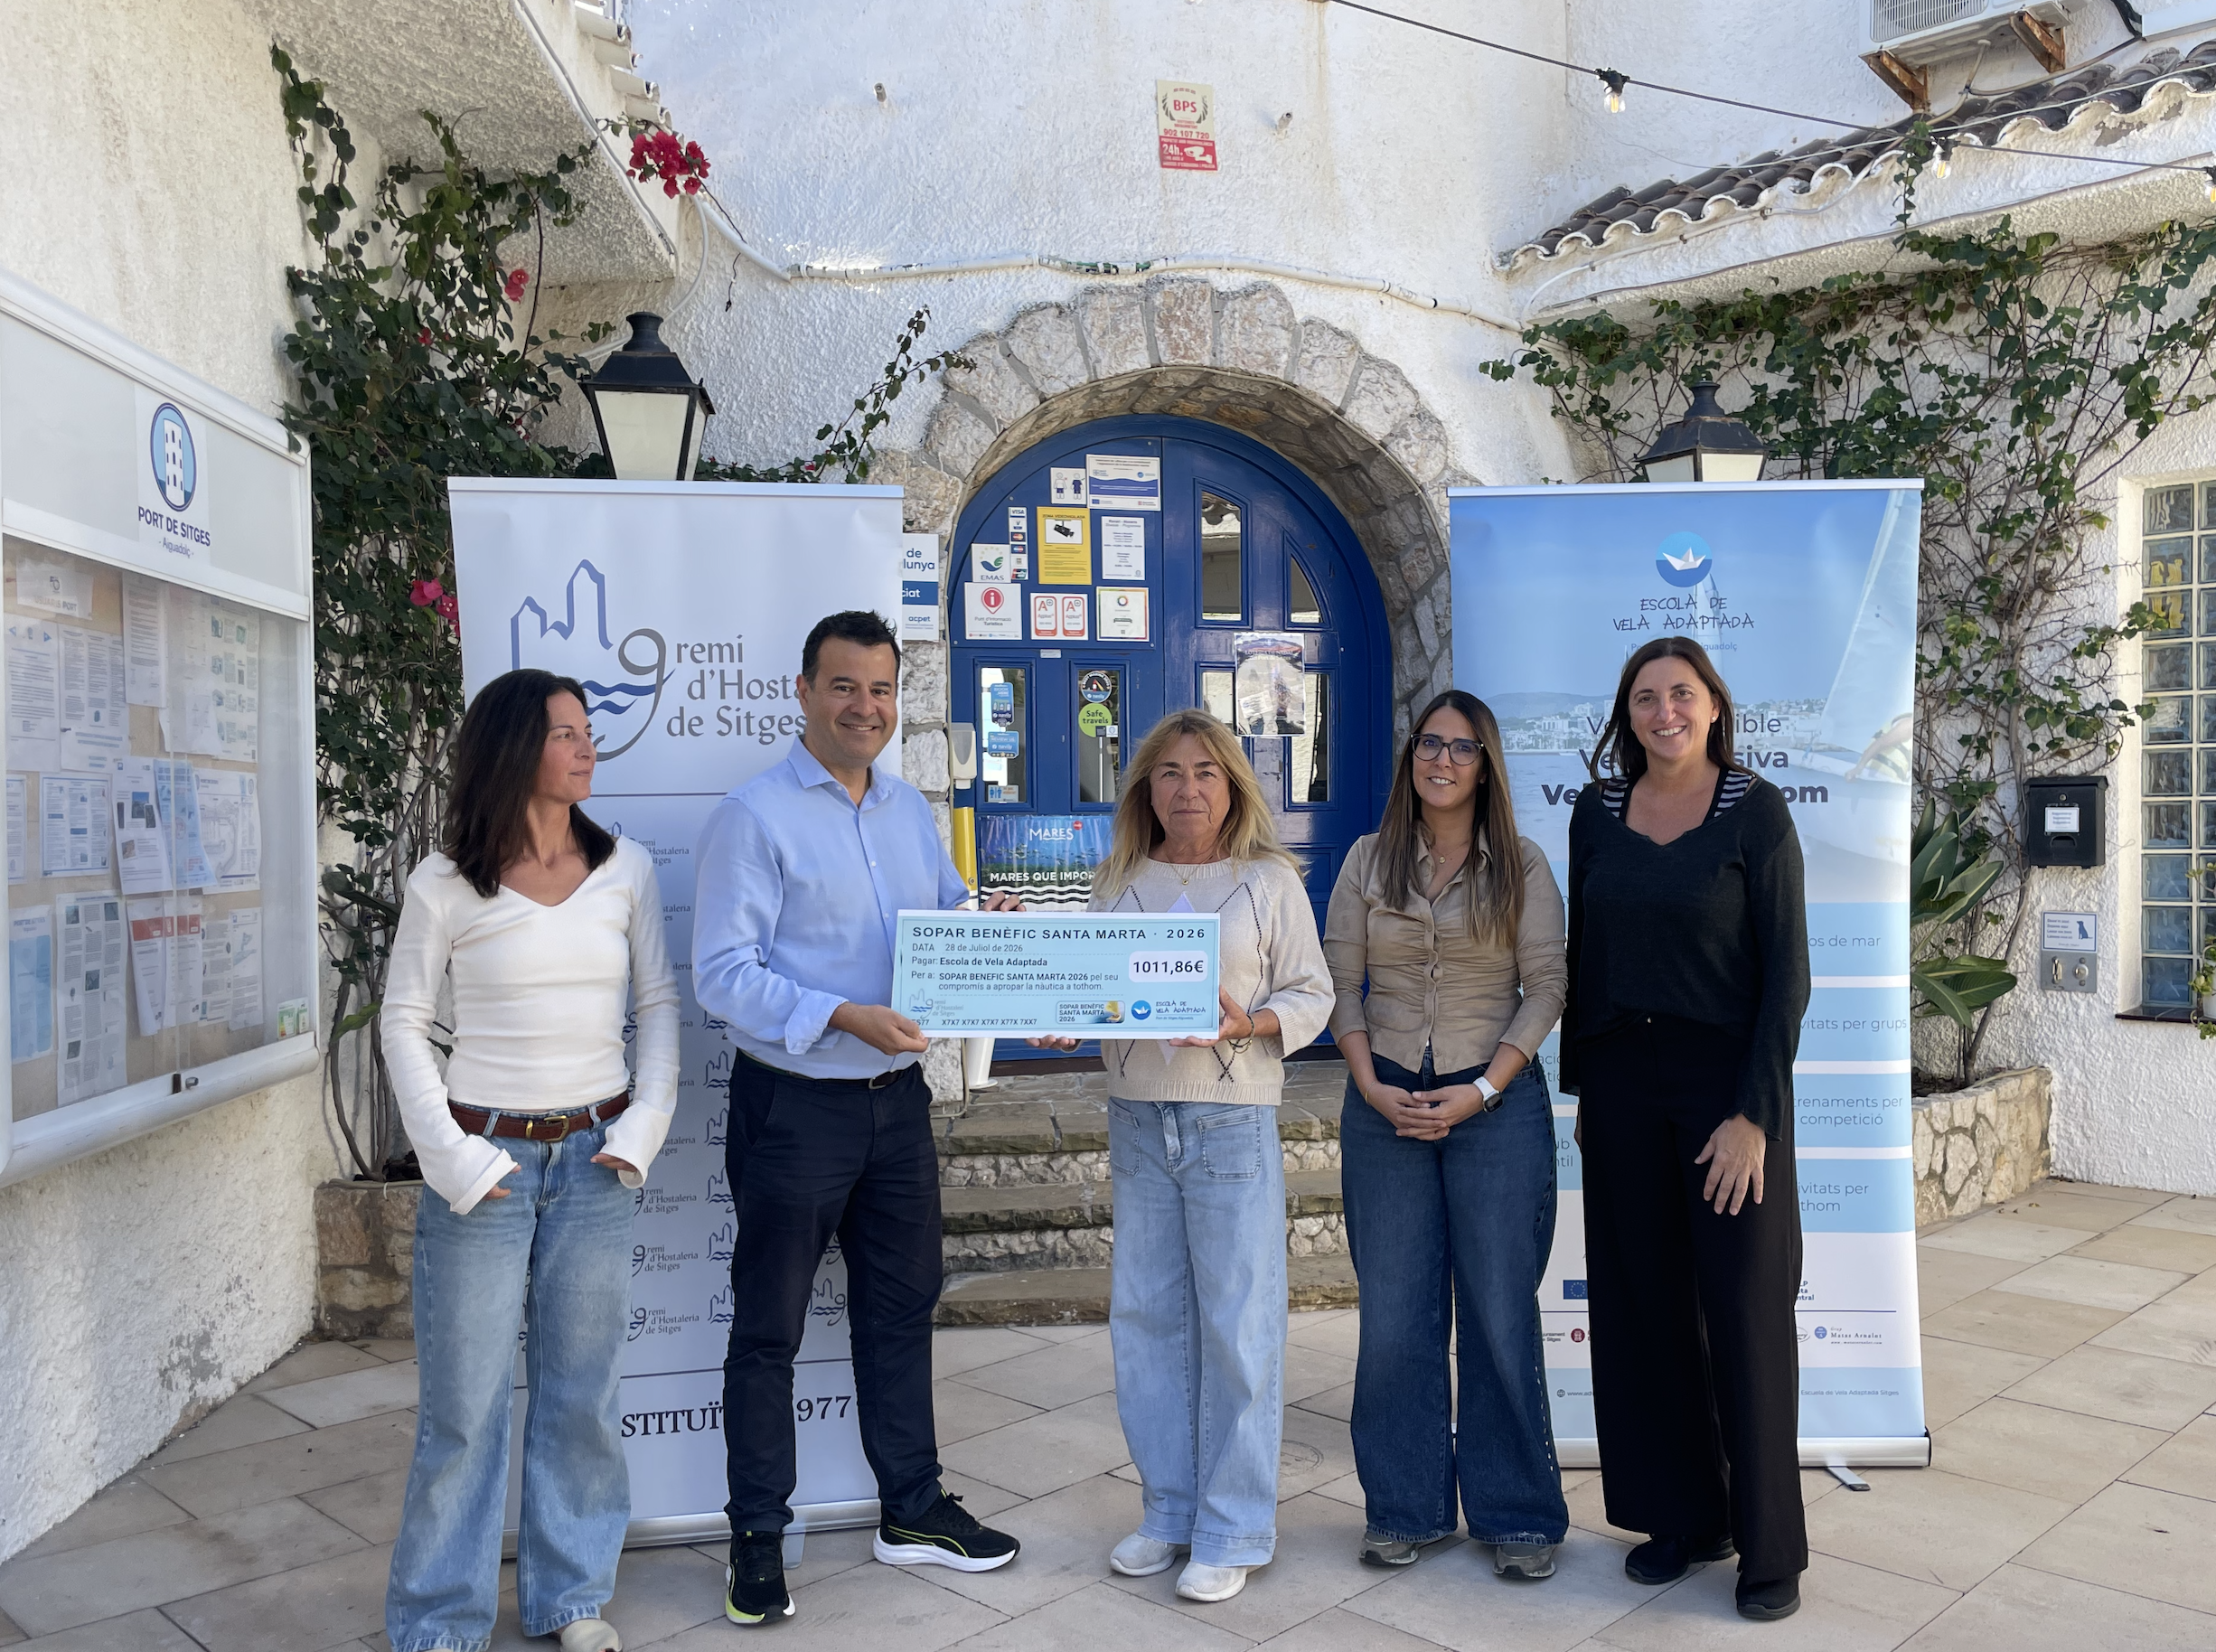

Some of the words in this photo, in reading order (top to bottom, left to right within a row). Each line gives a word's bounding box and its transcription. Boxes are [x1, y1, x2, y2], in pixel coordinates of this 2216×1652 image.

[1173, 99, 1197, 113] BPS
[1163, 128, 1178, 136] 902
[138, 506, 164, 530] PORT
[166, 517, 179, 535] DE
[181, 522, 211, 547] SITGES
[906, 548, 922, 558] de
[903, 558, 935, 572] lunya
[902, 588, 920, 597] ciat
[1640, 593, 1698, 611] ESCOLA
[1709, 597, 1727, 610] DE
[1612, 614, 1650, 631] VELA
[1662, 613, 1754, 630] ADAPTADA
[1701, 642, 1738, 652] iguadolç
[1086, 709, 1103, 718] Safe
[666, 706, 704, 737] de
[716, 705, 808, 746] Sitges
[1029, 828, 1074, 841] MARES
[990, 872, 1030, 882] MARES
[1032, 871, 1057, 881] QUE
[1059, 871, 1096, 880] IMPOR
[662, 904, 690, 913] staleria
[913, 927, 965, 938] SOPAR
[972, 926, 1037, 939] BENÈFIC
[1042, 929, 1091, 940] SANTA
[1095, 929, 1147, 940] MARTA
[1166, 929, 1205, 939] 2026
[1828, 935, 1847, 947] de
[1852, 937, 1881, 947] mar
[912, 943, 934, 952] DATA
[945, 943, 955, 952] 28
[957, 943, 967, 952] de
[968, 943, 991, 952] Juliol
[991, 943, 1001, 952] de
[1003, 944, 1023, 953] 2026
[911, 956, 938, 966] Pagar:
[940, 957, 970, 966] Escola
[972, 958, 982, 966] de
[984, 958, 1004, 966] Vela
[1006, 958, 1047, 968] Adaptada
[1132, 960, 1205, 975] 1011,86€
[911, 971, 925, 979] Per
[1068, 972, 1088, 981] 2026
[1090, 973, 1103, 982] pel
[938, 982, 984, 991] compromís
[1026, 982, 1033, 990] la
[1035, 982, 1065, 990] nàutica
[1073, 982, 1103, 990] tothom.
[1800, 1018, 1838, 1029] vitats
[1843, 1020, 1867, 1032] per
[1871, 1018, 1907, 1032] grups
[1882, 1097, 1903, 1111] per
[1800, 1112, 1883, 1127] competició
[1798, 1182, 1841, 1194] ivitats
[1845, 1185, 1869, 1197] per
[648, 1194, 697, 1204] d'Hostaleria
[643, 1205, 653, 1214] de
[655, 1204, 679, 1215] Sitges
[1800, 1199, 1841, 1212] thom
[650, 1251, 699, 1262] d'Hostaleria
[644, 1262, 654, 1272] de
[656, 1261, 681, 1272] Sitges
[651, 1314, 700, 1325] d'Hostaleria
[645, 1326, 655, 1335] de
[658, 1324, 681, 1335] Sitges
[621, 1401, 723, 1438] STITUÏ
